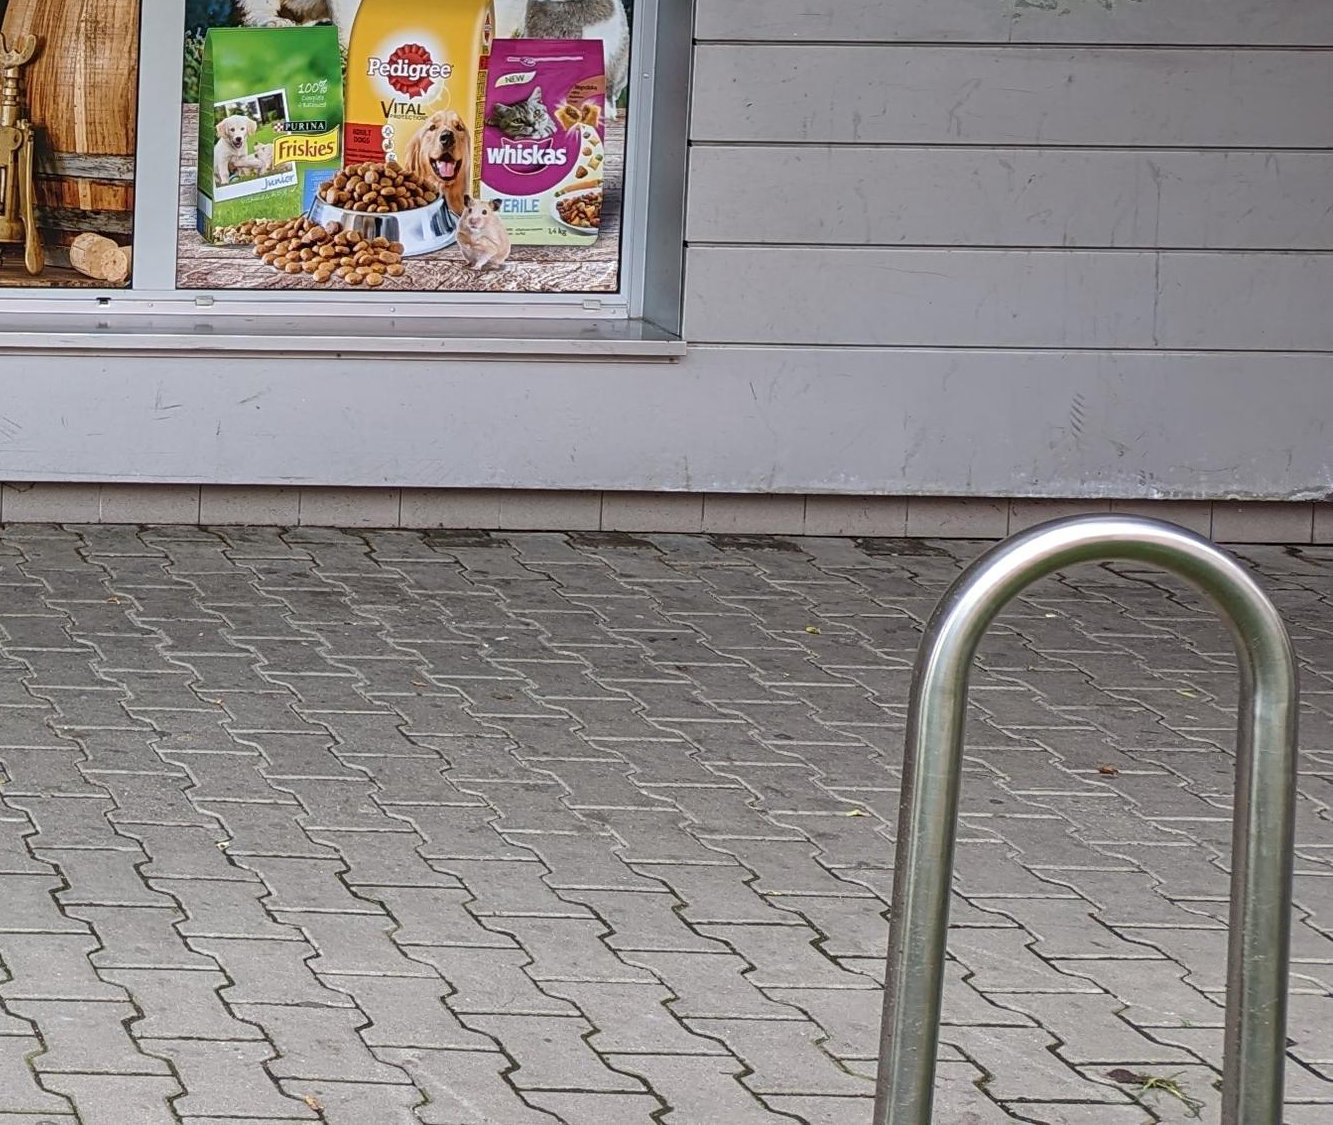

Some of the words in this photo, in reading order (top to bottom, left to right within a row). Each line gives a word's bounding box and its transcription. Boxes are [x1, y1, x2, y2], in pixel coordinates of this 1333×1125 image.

[367, 58, 452, 81] Pedigree
[505, 73, 526, 84] NEW
[298, 79, 327, 94] 100%
[285, 122, 325, 131] PURINA
[279, 140, 334, 160] Friskies
[487, 144, 568, 165] whiskas
[261, 174, 295, 190] Junior
[499, 198, 541, 213] ERILE
